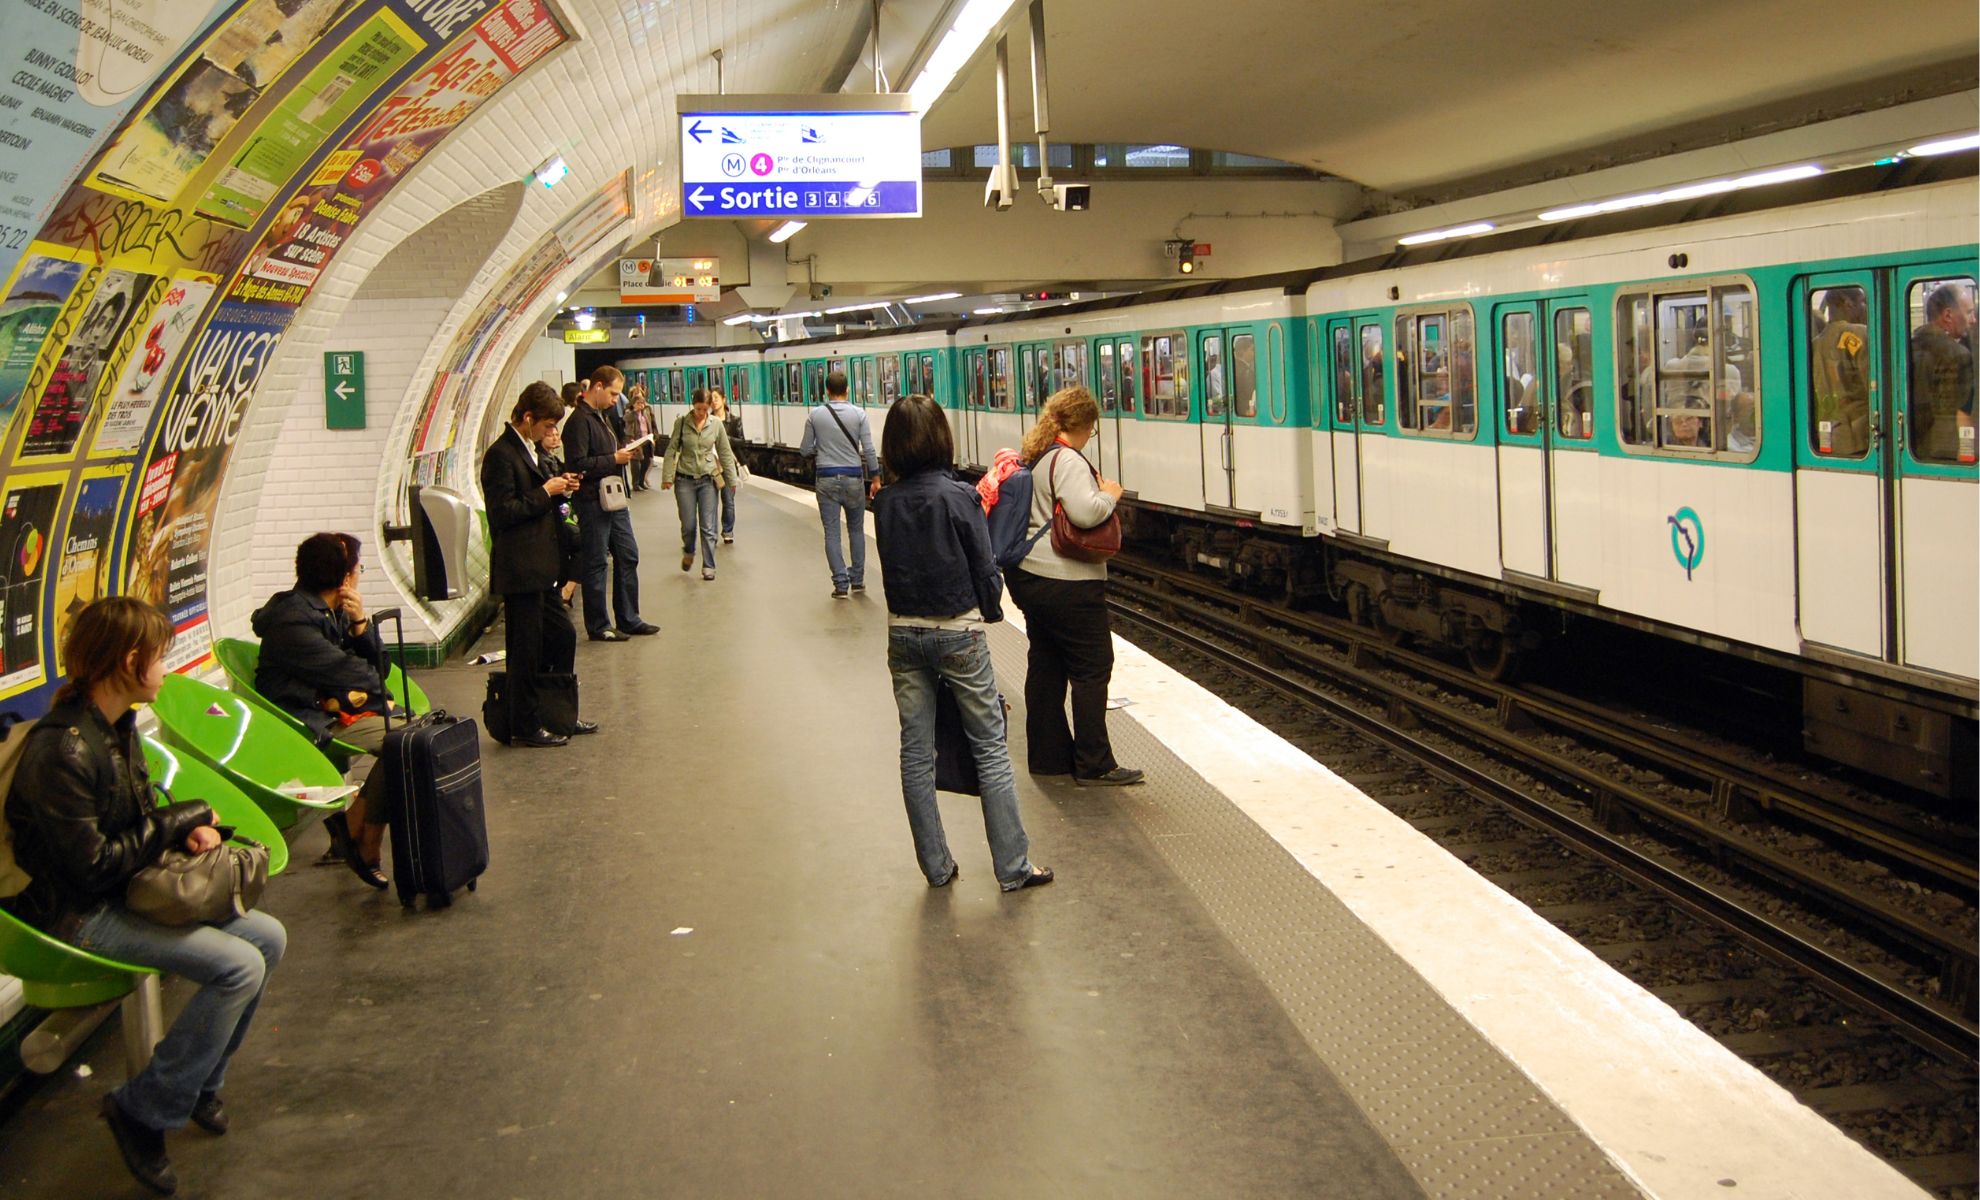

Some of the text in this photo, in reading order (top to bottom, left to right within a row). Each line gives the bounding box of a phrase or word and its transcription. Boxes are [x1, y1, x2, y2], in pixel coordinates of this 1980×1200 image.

[44, 2, 61, 17] EN
[57, 8, 83, 29] SCENE
[80, 20, 95, 35] DE
[121, 42, 154, 63] MOREAU
[24, 48, 57, 71] BUNNY
[12, 71, 74, 104] CECILE MAGNET
[720, 187, 798, 209] Sortie
[808, 193, 817, 206] 3
[827, 193, 838, 206] 4
[867, 193, 877, 206] 6
[313, 198, 360, 226] Denise Fabre
[5, 228, 28, 249] 22
[305, 226, 342, 249] Artistes
[283, 243, 326, 265] sur scène
[261, 261, 290, 276] Nouveau
[189, 329, 282, 393] VALSES
[165, 391, 252, 452] VIENNE
[66, 534, 99, 555] Chemins
